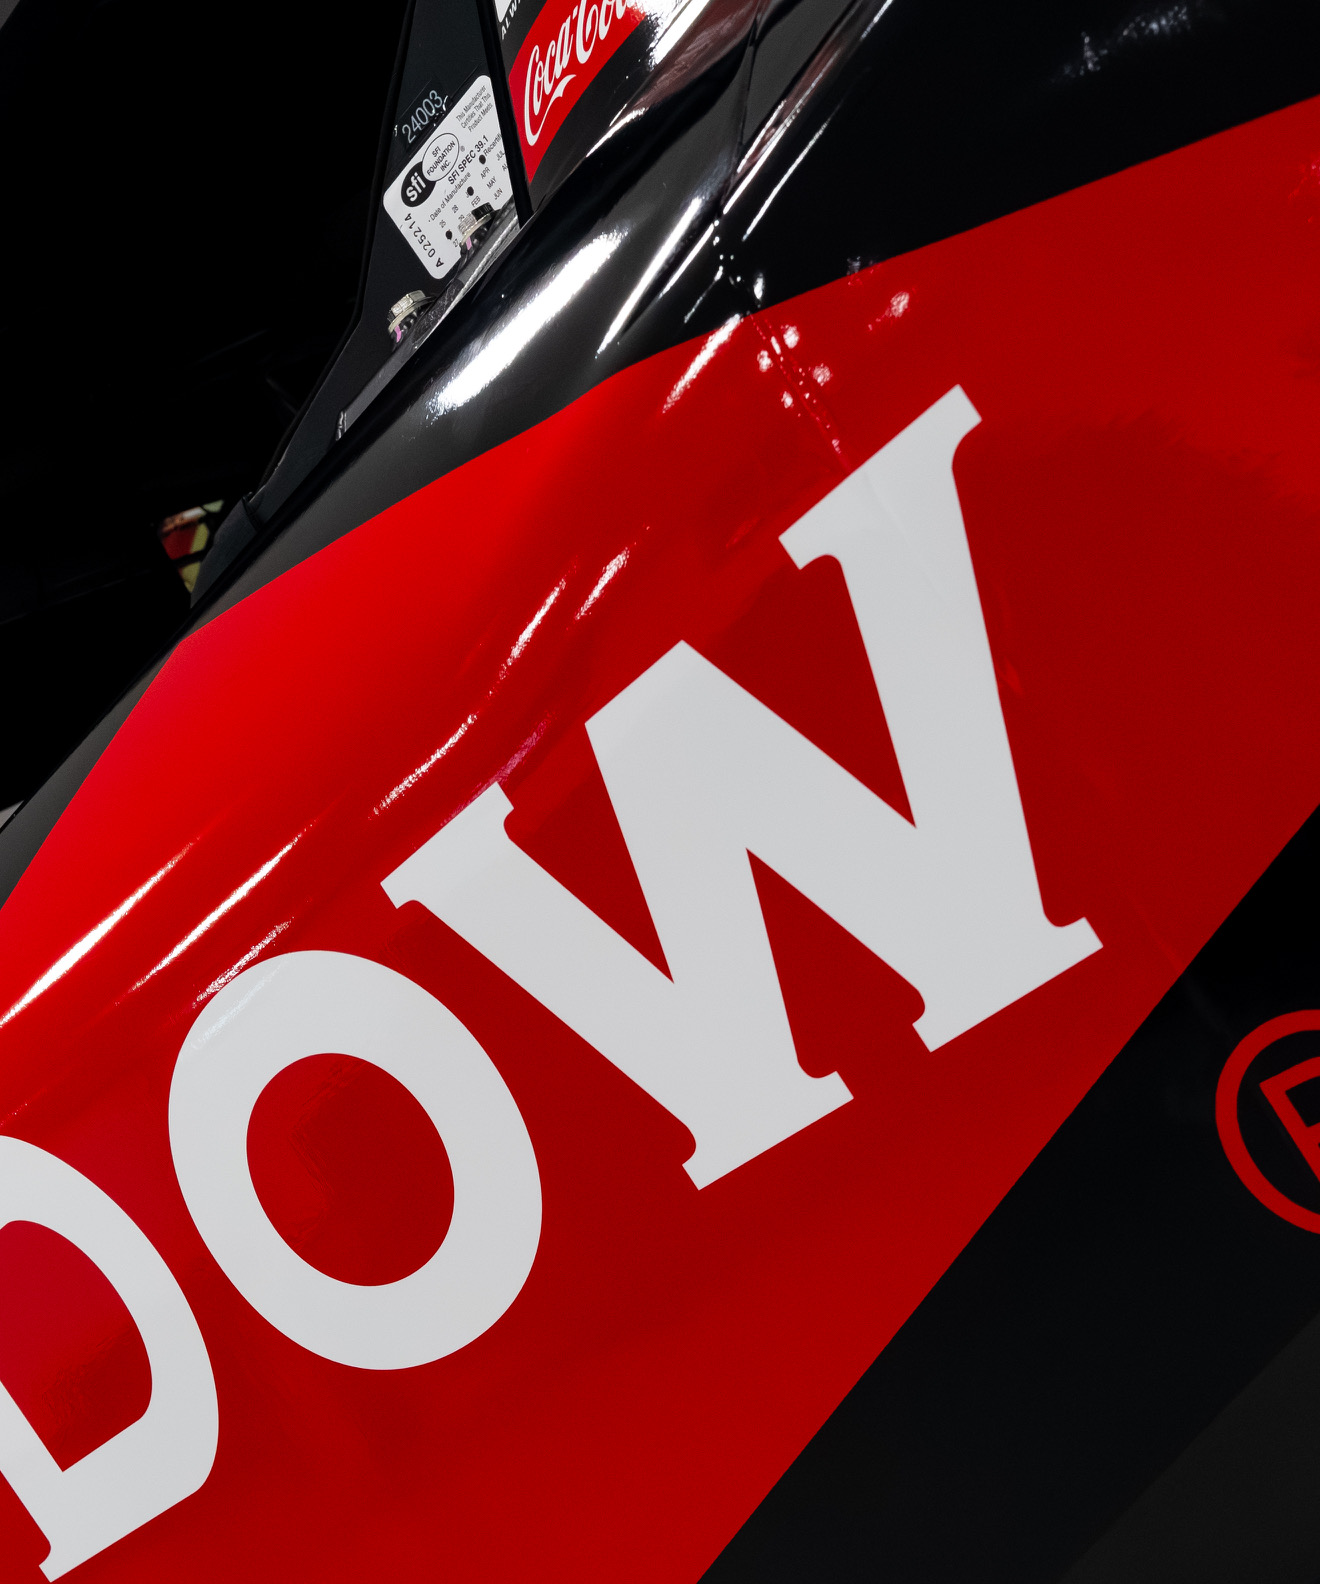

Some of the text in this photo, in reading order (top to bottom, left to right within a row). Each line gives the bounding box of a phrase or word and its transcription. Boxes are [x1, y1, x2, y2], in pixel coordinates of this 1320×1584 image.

[402, 90, 443, 143] 24003
[456, 111, 465, 122] This
[468, 114, 483, 132] Product
[426, 140, 456, 176] FOUNDATION
[431, 146, 441, 158] SFI
[440, 161, 451, 171] INC.
[448, 170, 460, 185] SFI
[458, 150, 477, 173] SPEC
[474, 135, 489, 152] 39.1
[480, 166, 490, 179] APR
[405, 171, 427, 202] sfi
[486, 176, 497, 189] MAY
[430, 207, 441, 221] Date
[440, 200, 446, 209] of
[445, 172, 471, 203] Manufacture
[493, 187, 503, 200] JUN
[435, 258, 444, 268] A
